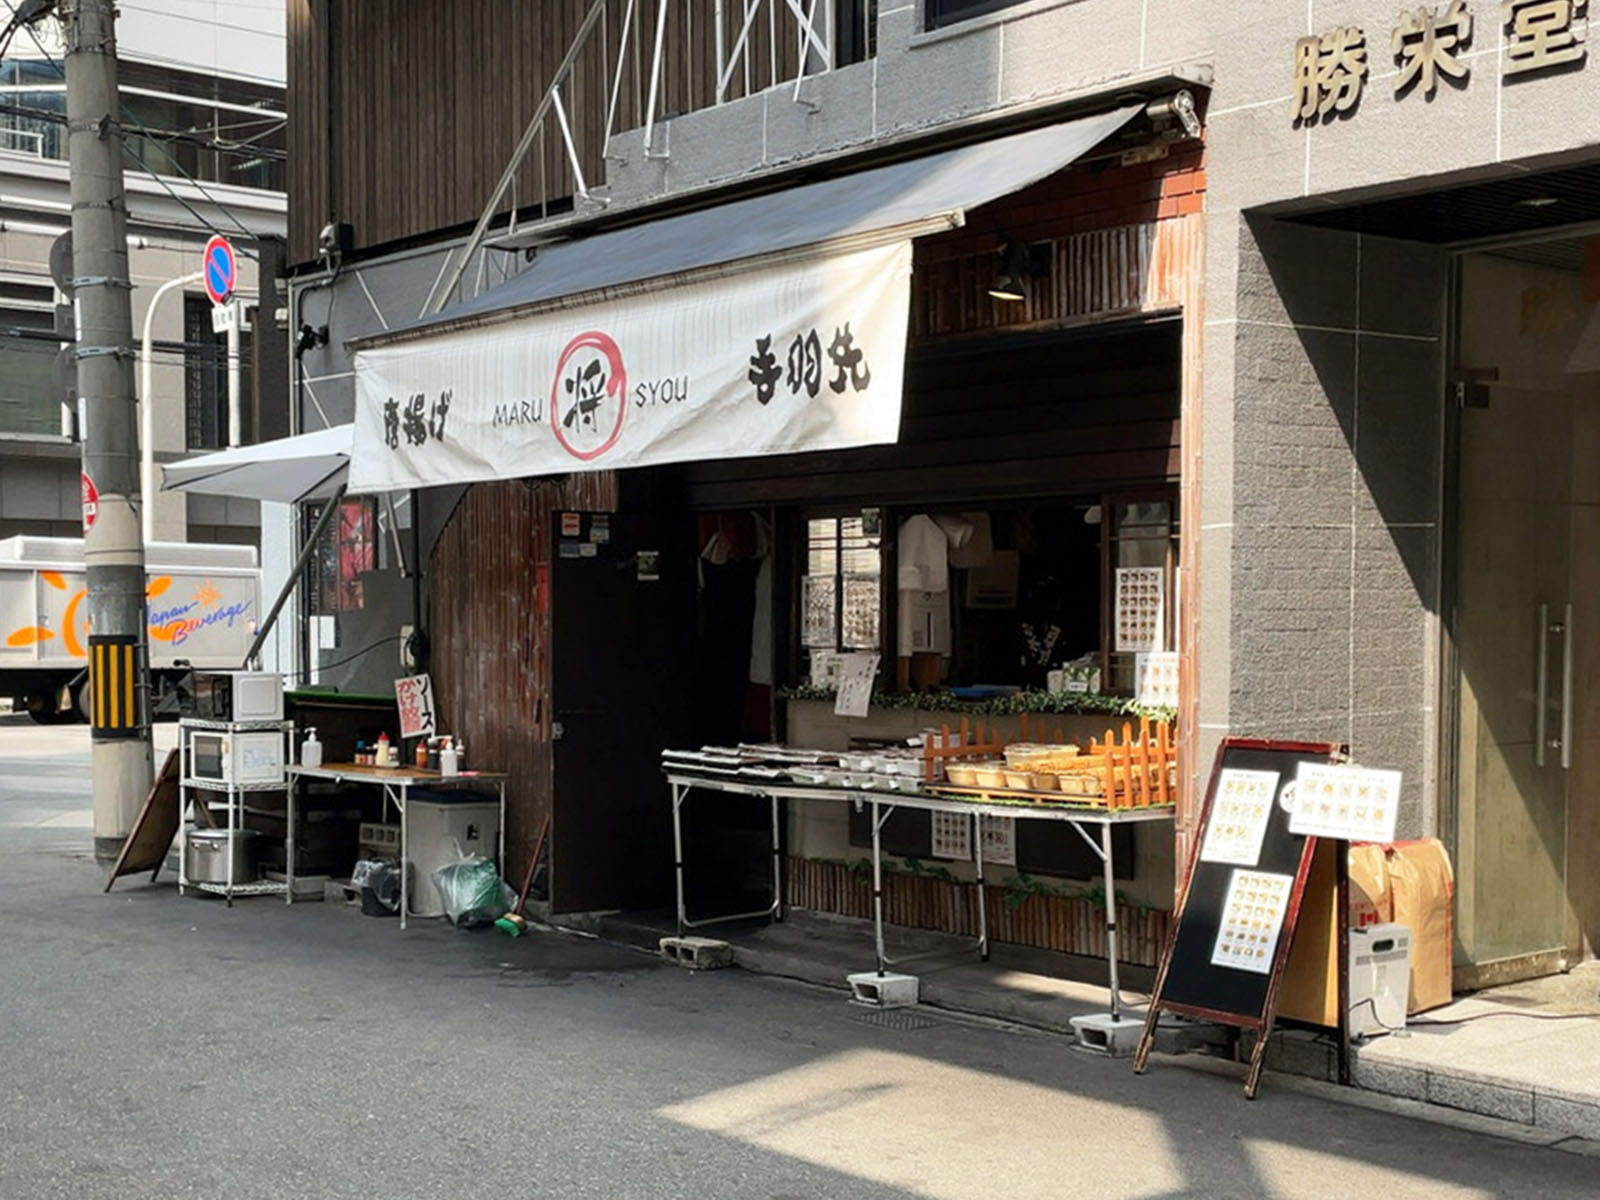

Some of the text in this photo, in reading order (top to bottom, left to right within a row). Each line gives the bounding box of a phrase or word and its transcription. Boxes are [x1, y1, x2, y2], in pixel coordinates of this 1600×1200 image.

[1290, 0, 1588, 122] 勝栄堂
[383, 388, 453, 450] 唐揚げ
[492, 358, 689, 435] MARU 将 SYOU
[163, 599, 253, 646] Beverage
[415, 676, 434, 730] ソース
